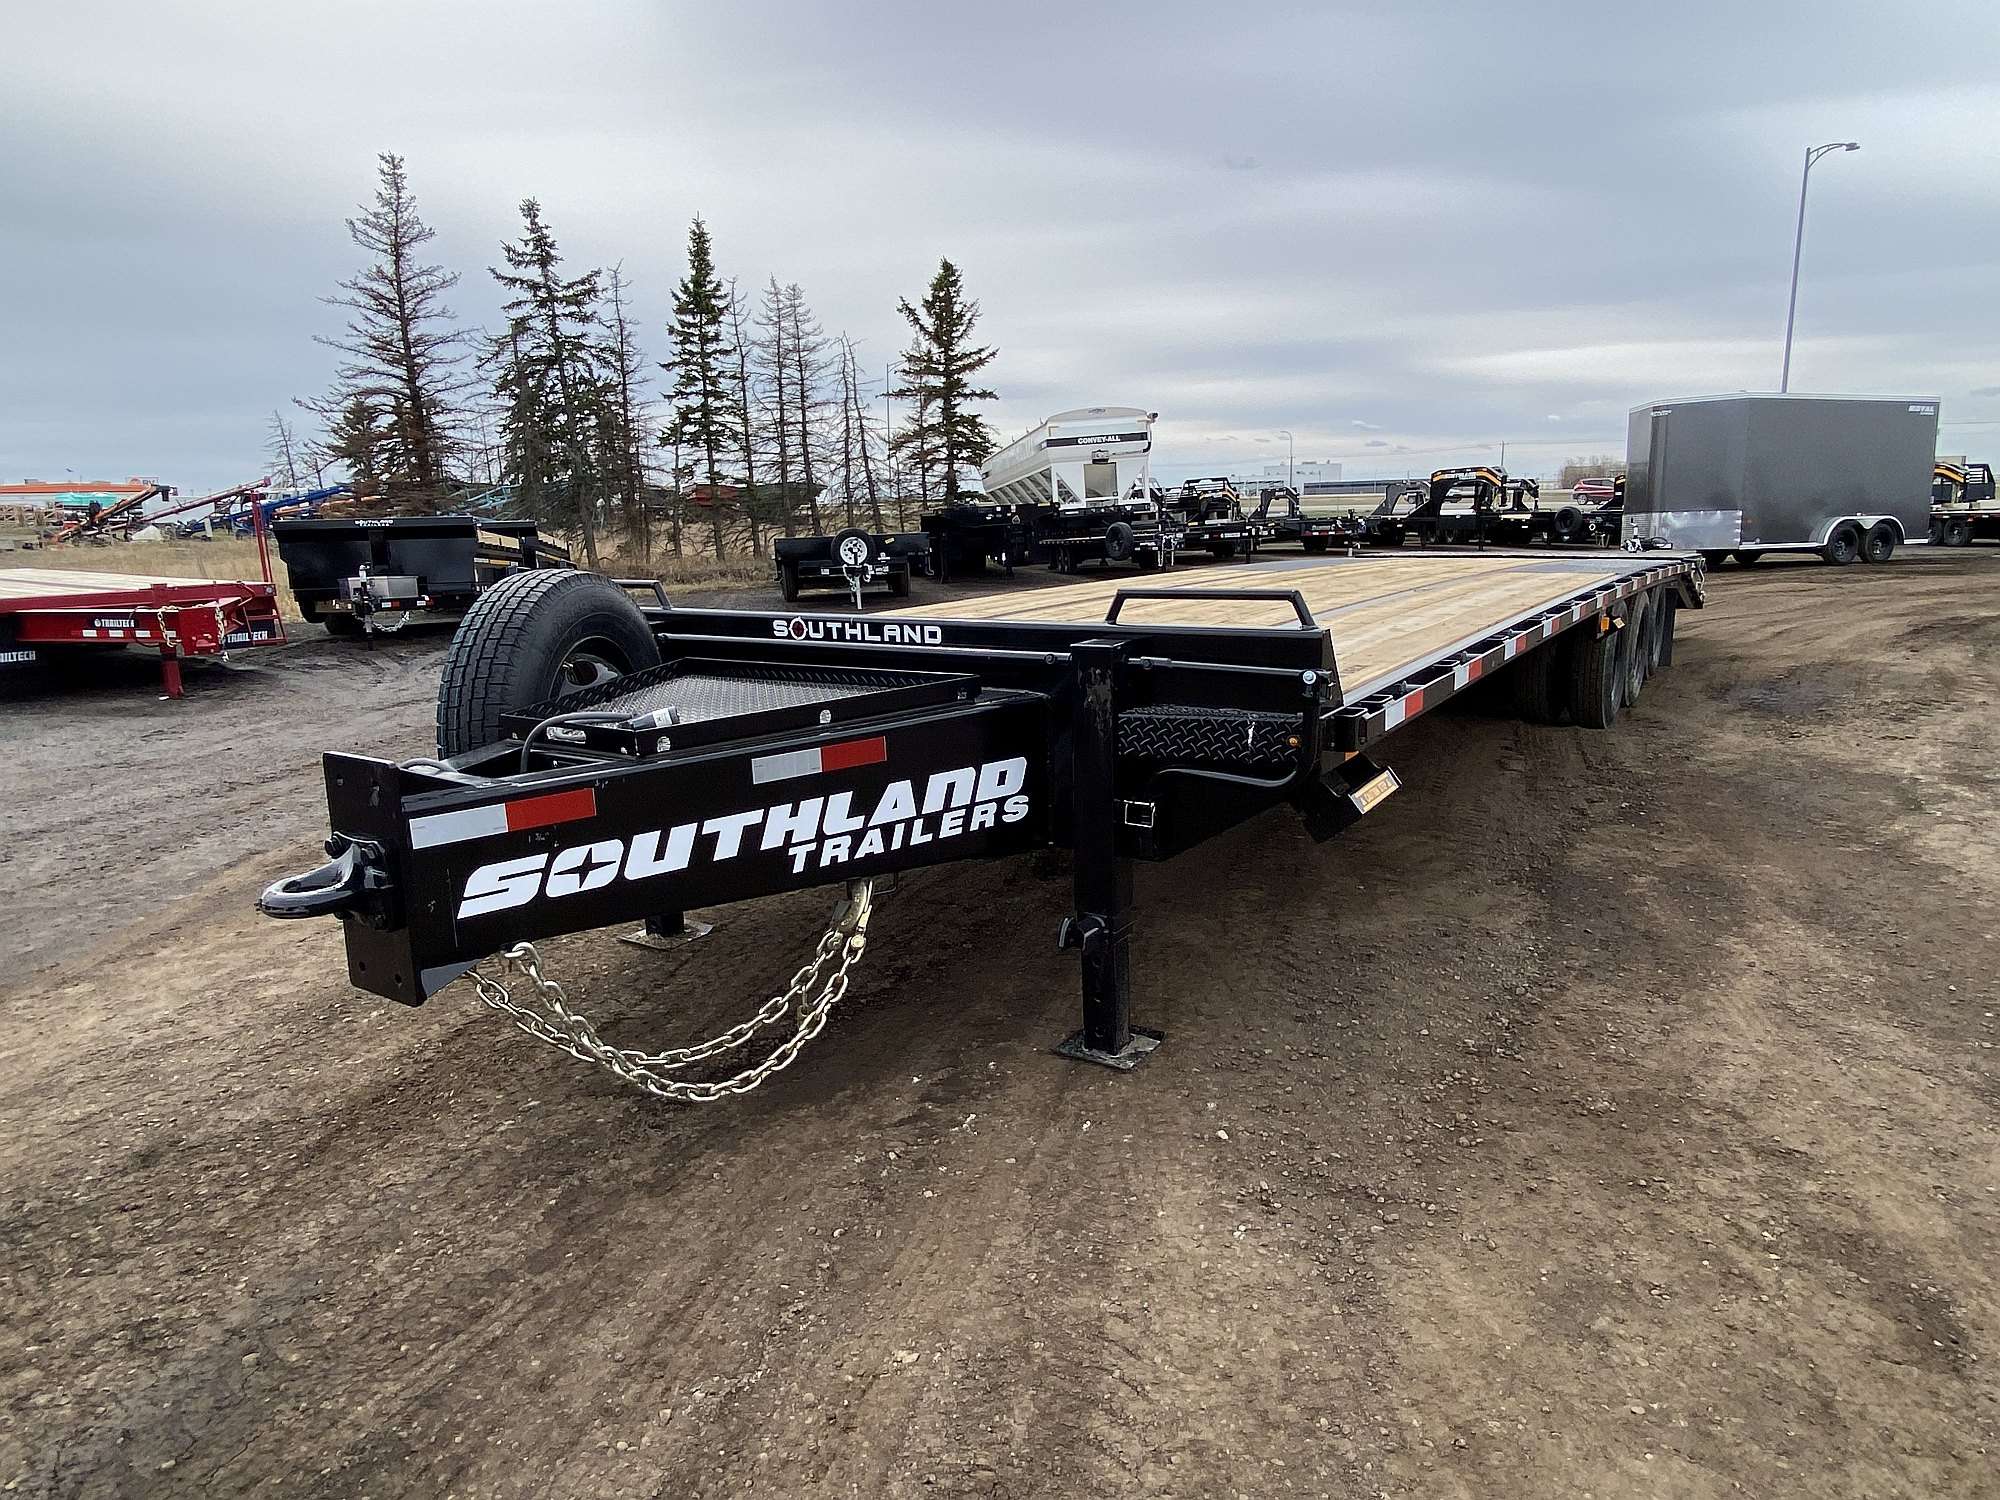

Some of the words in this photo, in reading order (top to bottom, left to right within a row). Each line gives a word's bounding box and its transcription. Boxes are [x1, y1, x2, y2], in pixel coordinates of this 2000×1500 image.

[1077, 435, 1121, 444] CONVEY-ALL
[773, 616, 942, 645] SOUTHLAND
[456, 756, 1028, 920] SOUTHLAND
[788, 795, 1029, 873] TRAILERS
